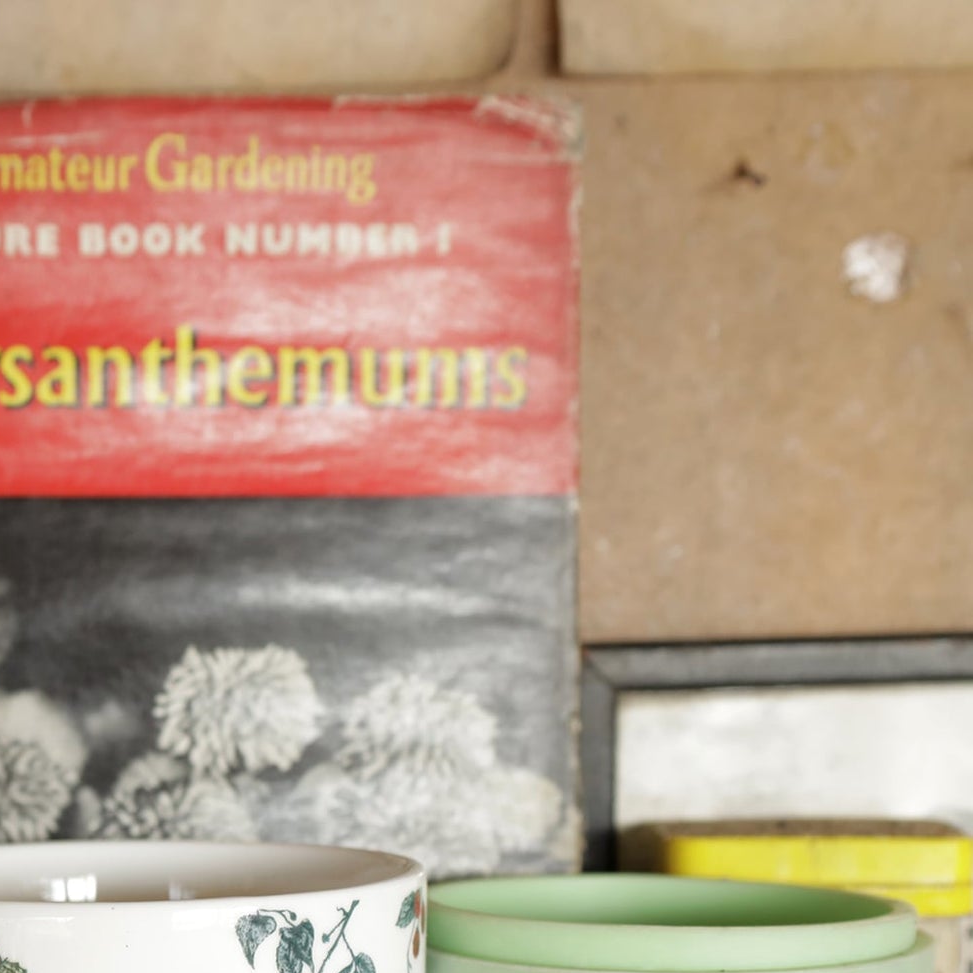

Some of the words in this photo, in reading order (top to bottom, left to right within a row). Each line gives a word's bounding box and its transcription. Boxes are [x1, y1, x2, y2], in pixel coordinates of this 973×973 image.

[144, 131, 377, 207] Gardening
[79, 221, 207, 257] BOOK
[227, 221, 420, 257] NUMBER
